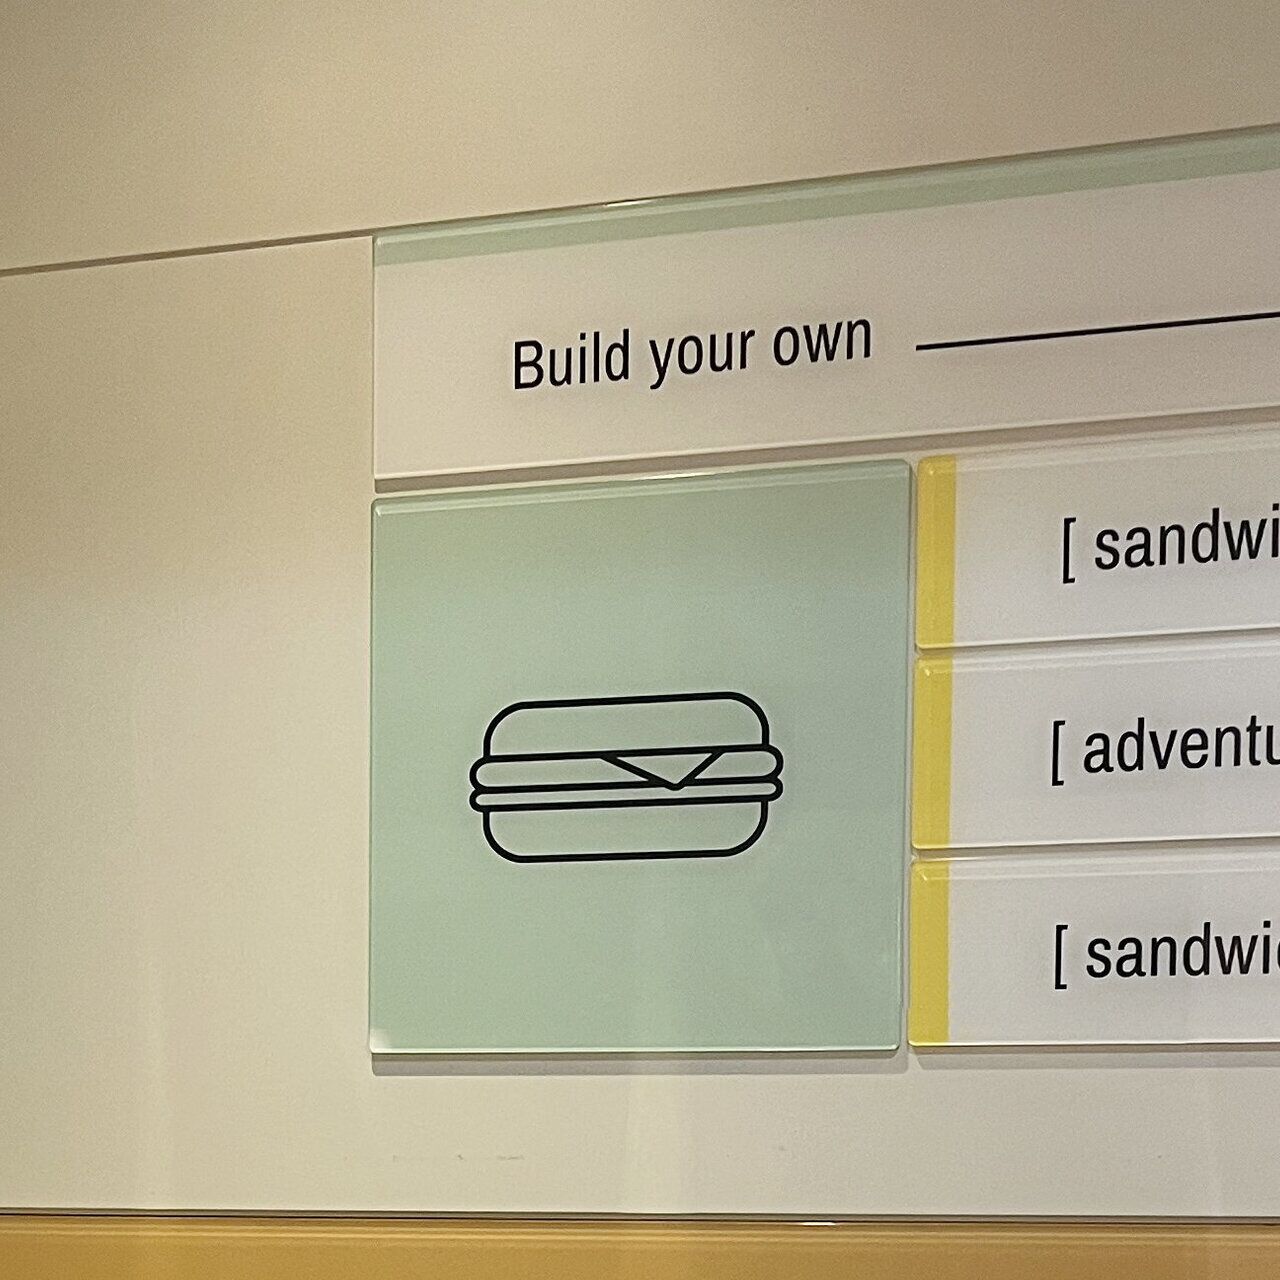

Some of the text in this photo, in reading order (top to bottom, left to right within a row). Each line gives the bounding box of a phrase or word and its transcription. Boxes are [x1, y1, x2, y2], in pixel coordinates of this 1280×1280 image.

[514, 318, 871, 391] Build your own
